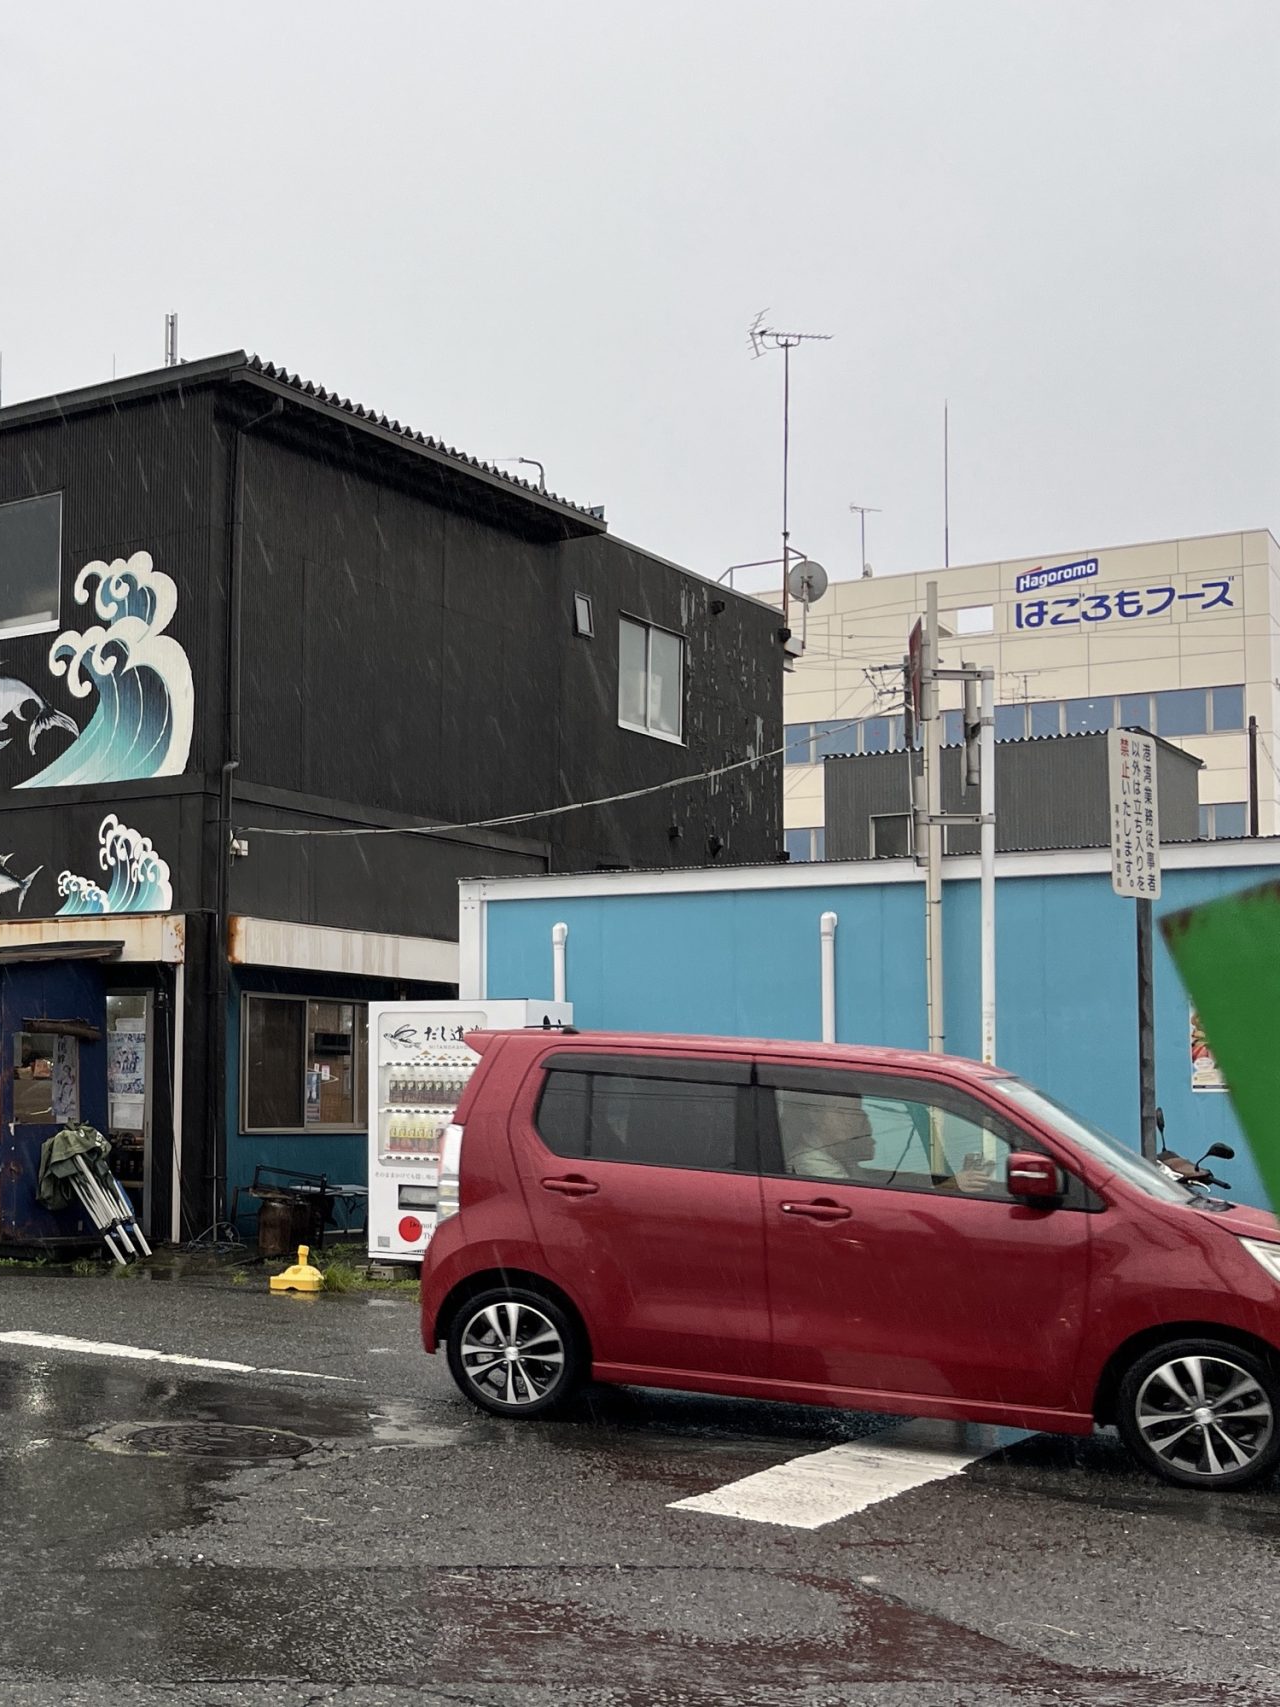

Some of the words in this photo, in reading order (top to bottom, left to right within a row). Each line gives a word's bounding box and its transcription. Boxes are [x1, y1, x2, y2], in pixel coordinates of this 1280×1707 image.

[1016, 576, 1234, 629] はごろもフーズ
[1019, 561, 1097, 590] Hagoromo
[1121, 738, 1134, 887] 禁止いたします。
[1132, 741, 1145, 891] 以外は立ち入りを
